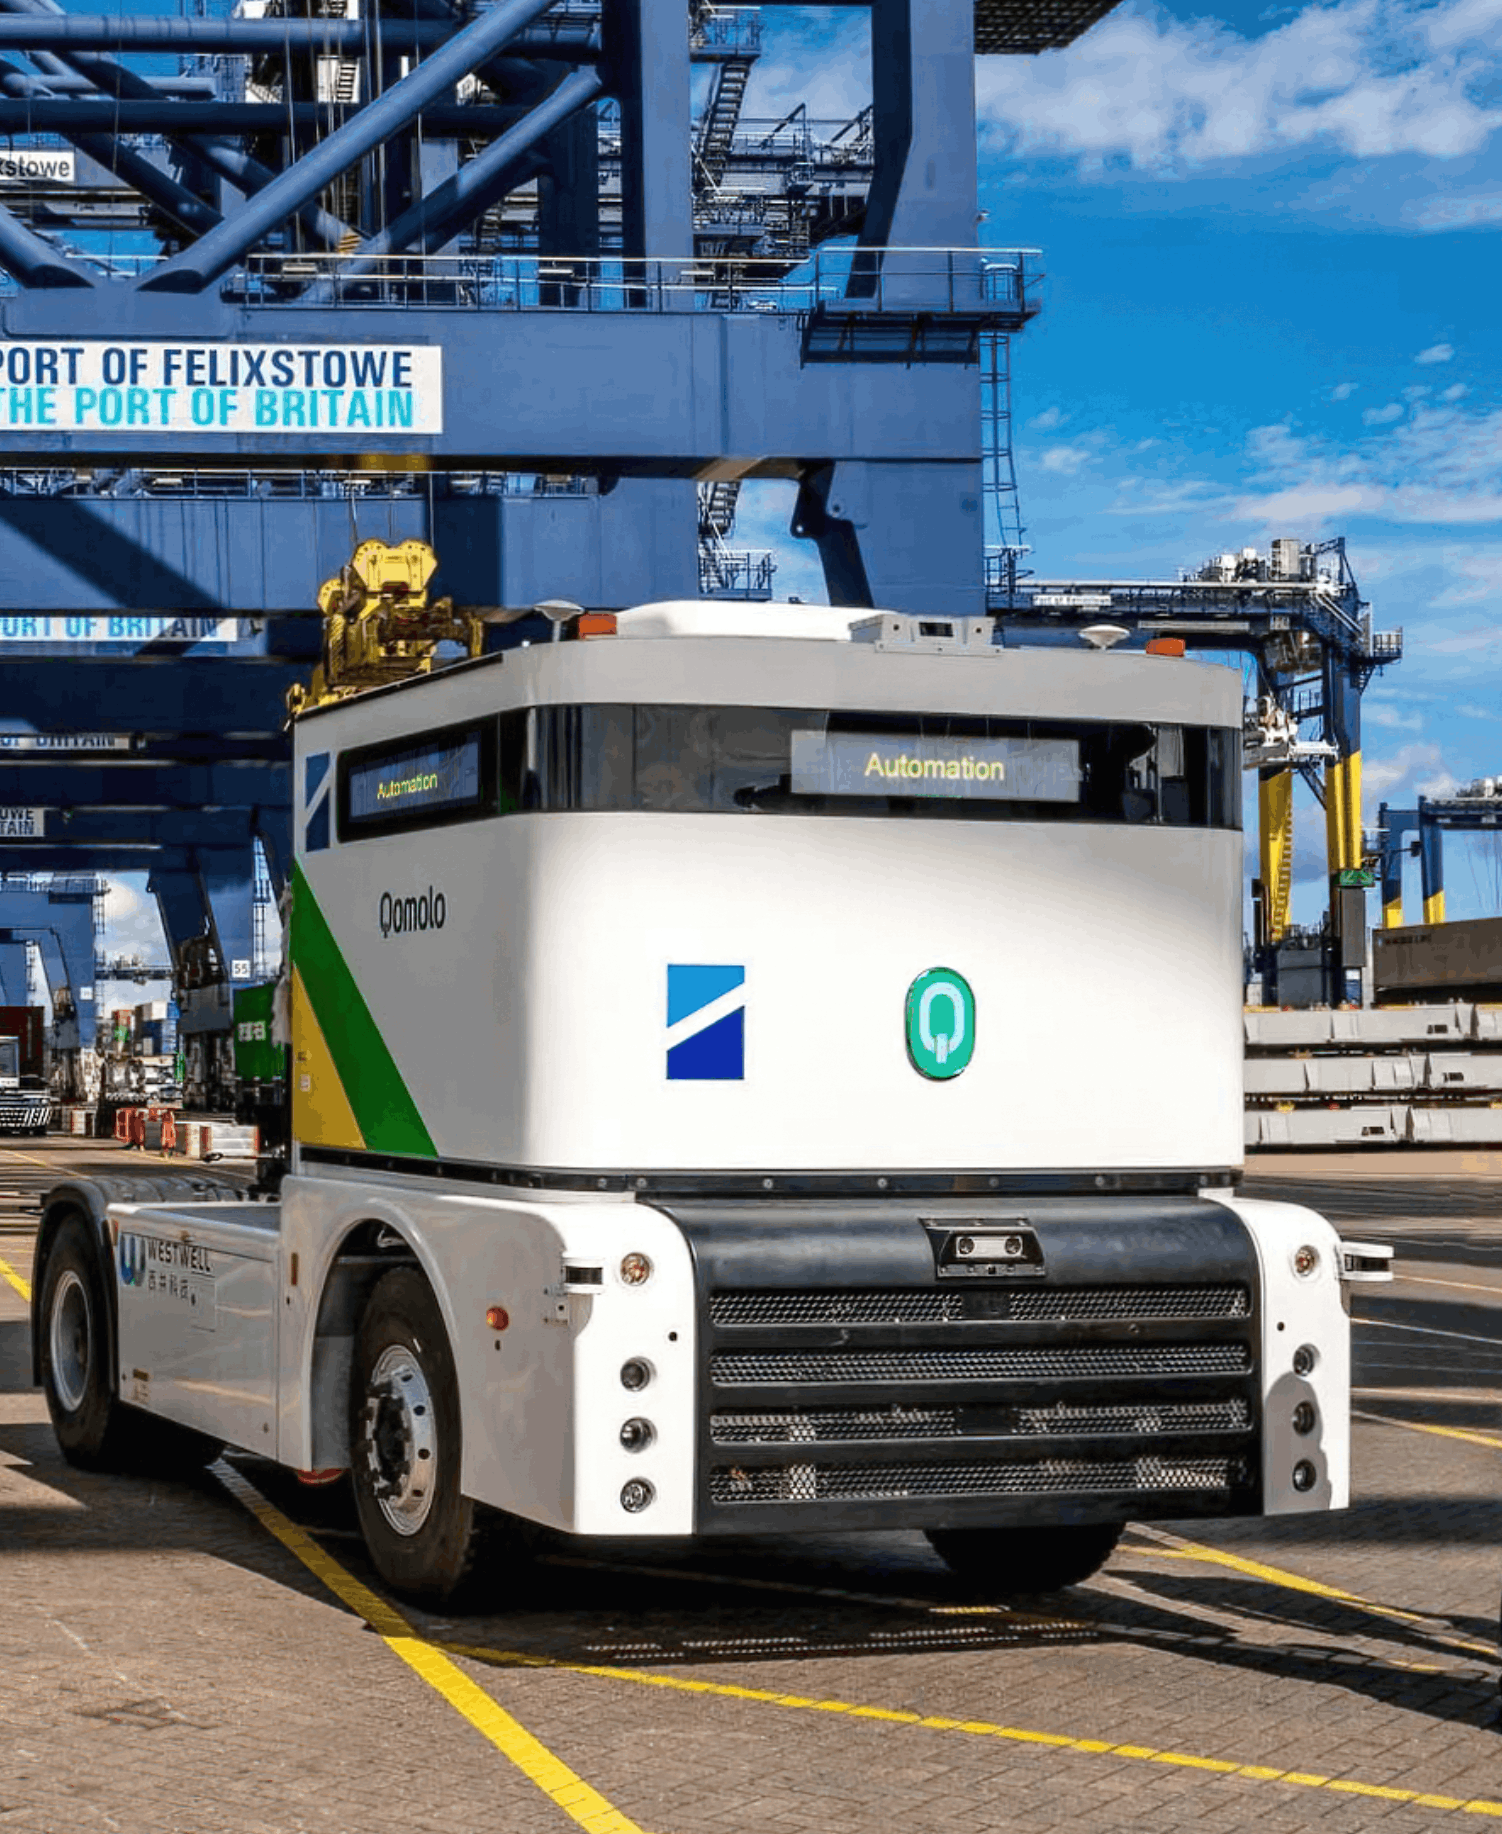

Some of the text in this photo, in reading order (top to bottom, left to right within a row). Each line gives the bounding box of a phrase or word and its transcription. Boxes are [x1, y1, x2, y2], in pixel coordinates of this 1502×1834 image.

[102, 347, 148, 385] OF
[163, 349, 412, 388] FELIXSTOWE
[75, 387, 177, 426] PORT
[191, 387, 238, 426] OF
[255, 389, 413, 427] BRITAIN
[66, 615, 98, 637] OF
[108, 615, 220, 637] BRITAIN
[864, 752, 1005, 781] Automation
[376, 773, 438, 800] Automation
[379, 885, 446, 939] Qomolo
[234, 963, 248, 974] 55
[148, 1240, 211, 1273] WESTWELL
